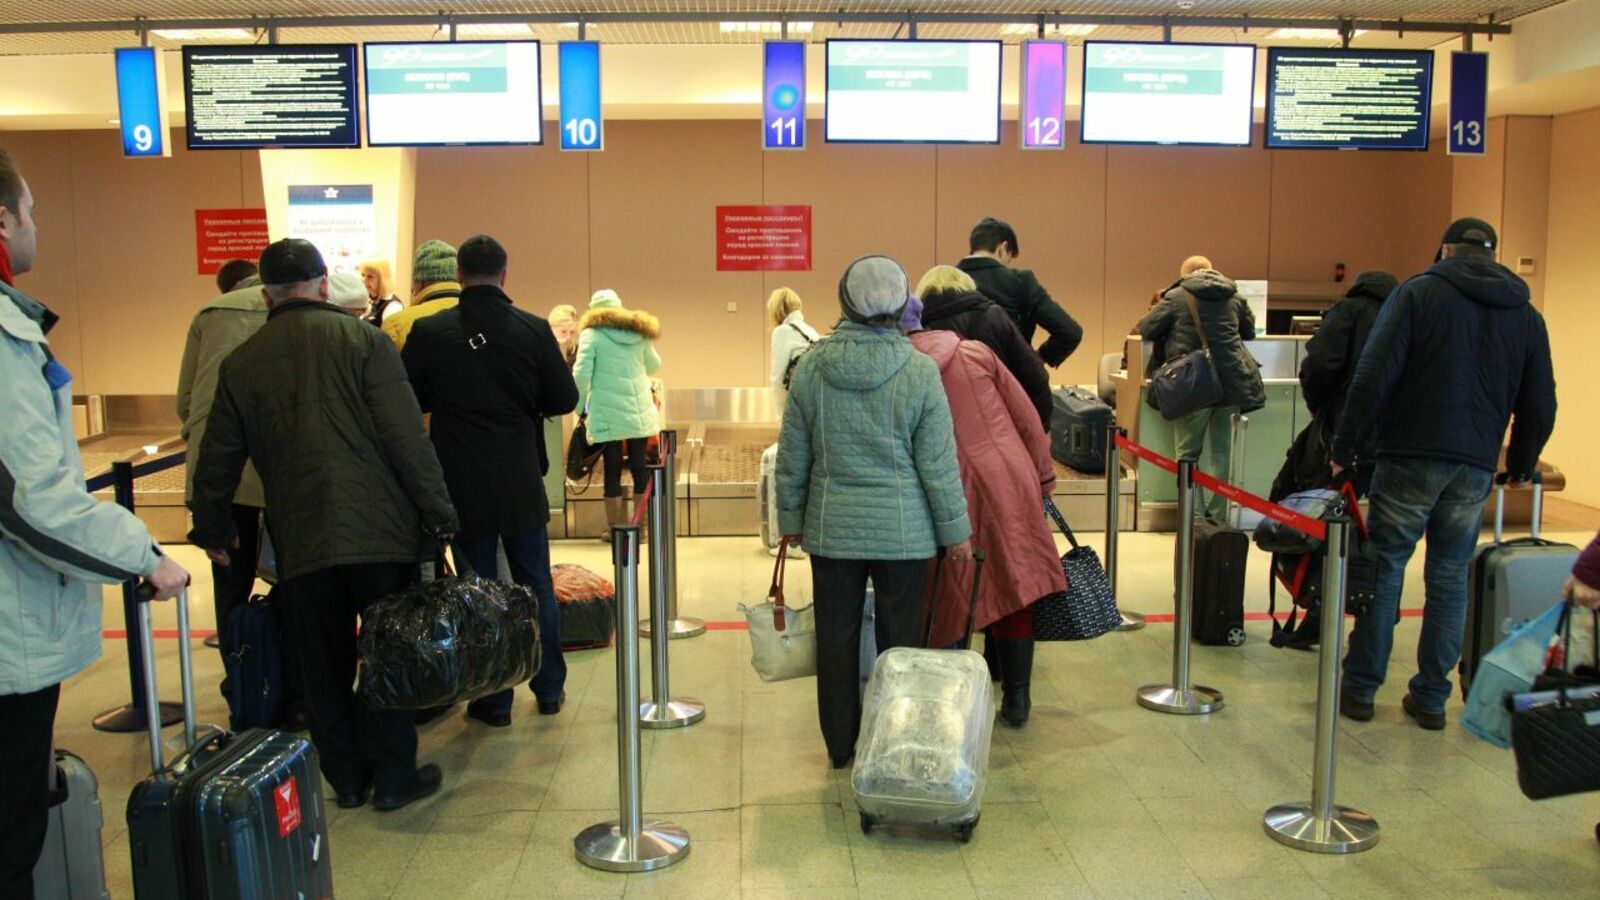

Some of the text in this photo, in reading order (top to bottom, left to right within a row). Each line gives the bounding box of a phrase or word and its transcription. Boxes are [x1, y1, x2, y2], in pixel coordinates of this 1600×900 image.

[133, 124, 153, 152] 9
[565, 118, 597, 146] 10
[771, 117, 796, 146] 11
[1028, 116, 1060, 146] 12
[1452, 120, 1482, 147] 13
